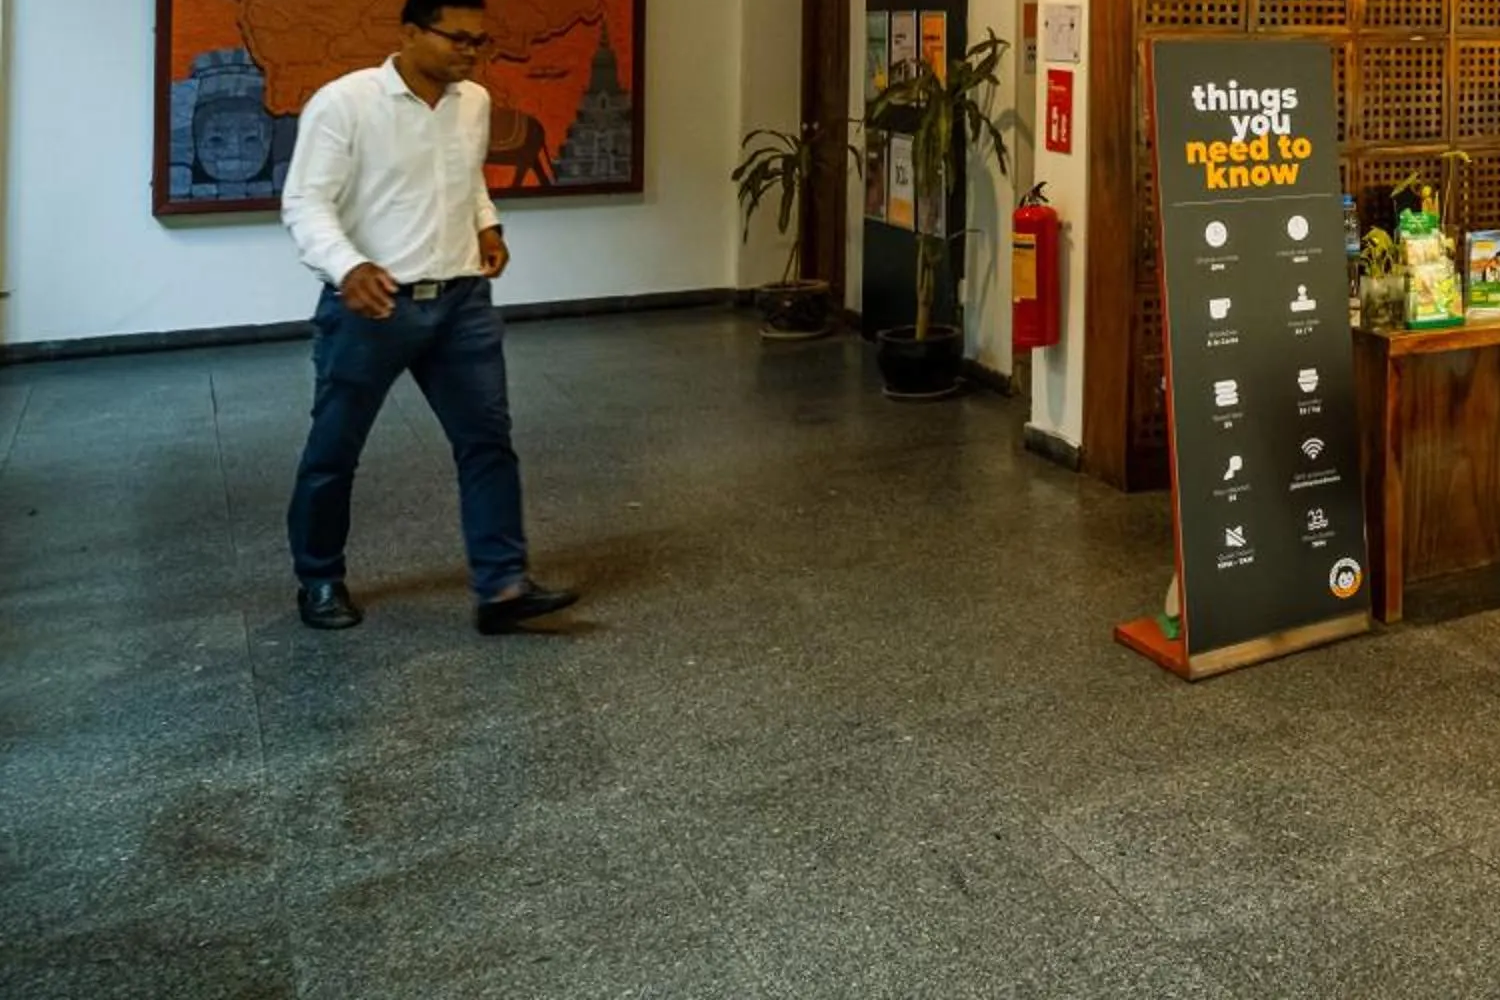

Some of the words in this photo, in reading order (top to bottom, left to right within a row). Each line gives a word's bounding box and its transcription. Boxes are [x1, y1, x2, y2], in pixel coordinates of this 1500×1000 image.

[1191, 80, 1299, 116] things
[1229, 113, 1292, 143] you
[1186, 134, 1270, 164] need
[1278, 135, 1312, 160] to
[1206, 160, 1299, 189] know
